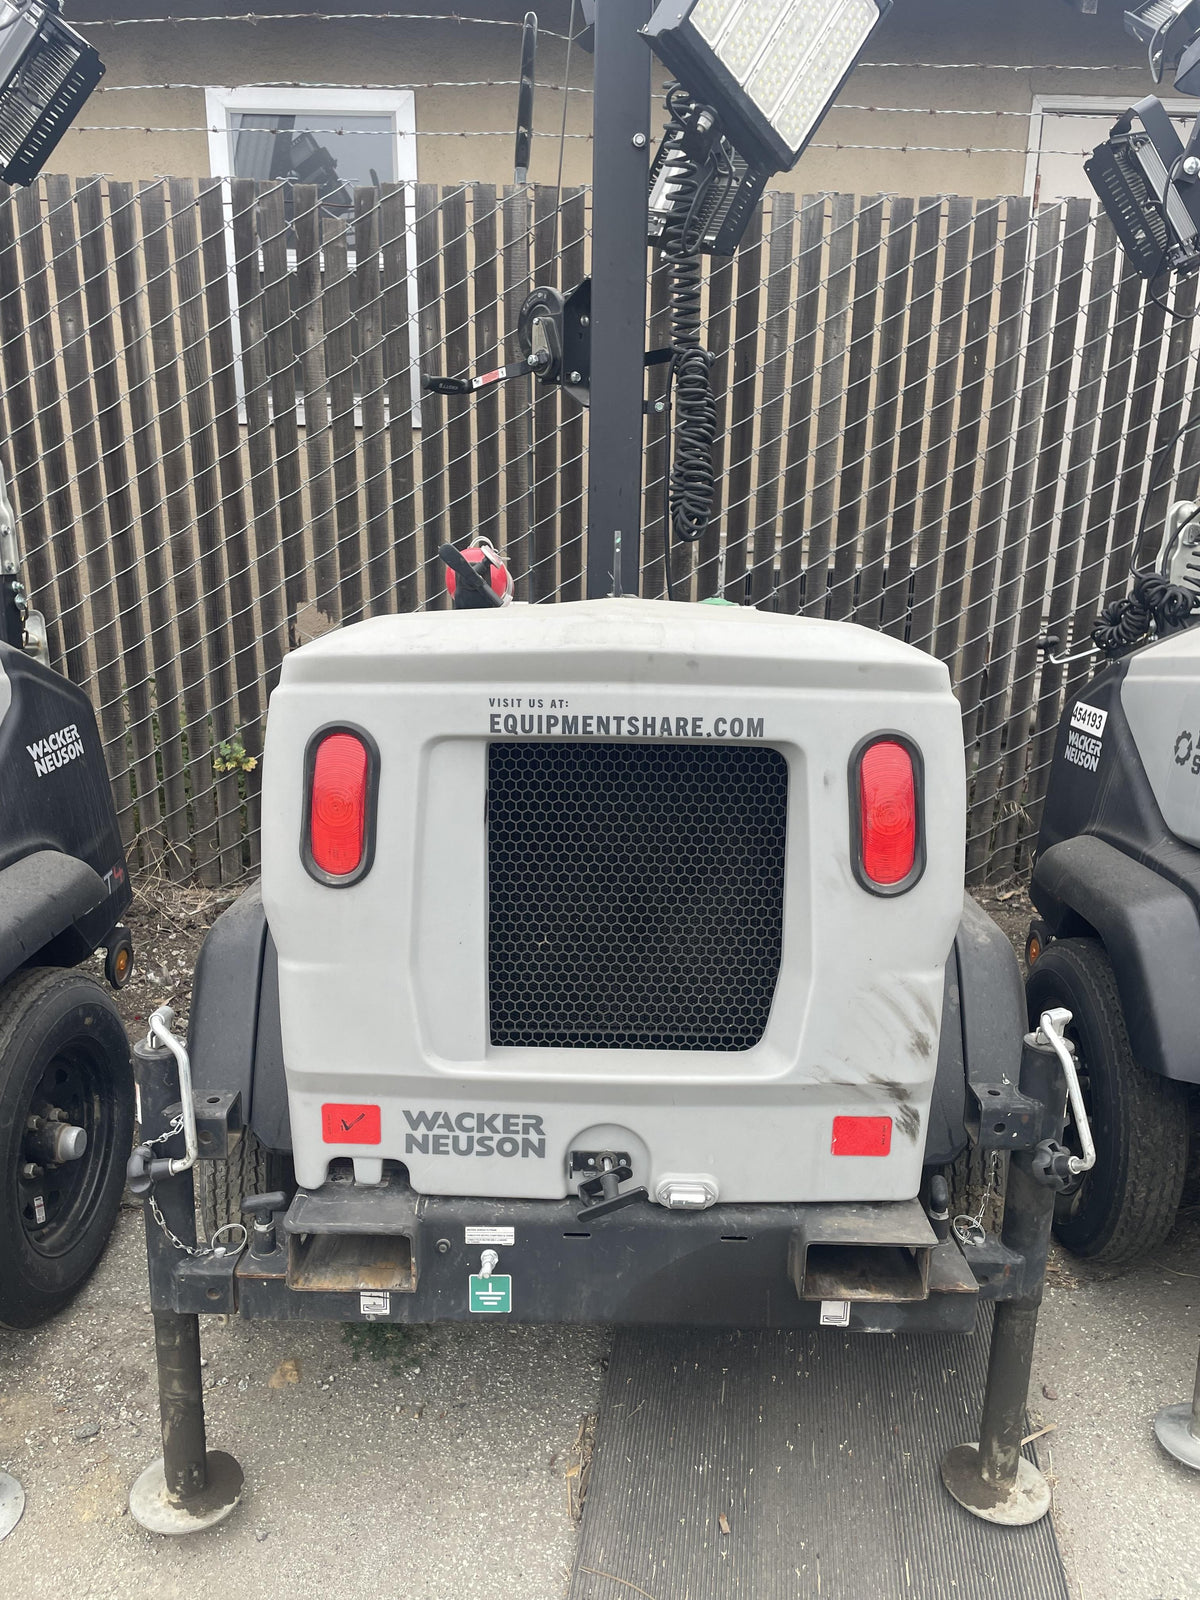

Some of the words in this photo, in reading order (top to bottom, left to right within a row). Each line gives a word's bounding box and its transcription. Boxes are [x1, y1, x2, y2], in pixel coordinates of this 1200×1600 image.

[489, 698, 522, 708] VISIT
[528, 698, 544, 708] US
[550, 699, 569, 709] AT:
[489, 713, 765, 738] EQUIPMENTSHARE.COM
[1071, 706, 1104, 730] 454193
[26, 724, 80, 760] WACKER
[1068, 730, 1103, 757] WACKER
[34, 739, 84, 777] NEUSON
[1064, 745, 1100, 772] NEUSON
[402, 1110, 546, 1135] WACKER
[405, 1133, 546, 1158] NEUSON
